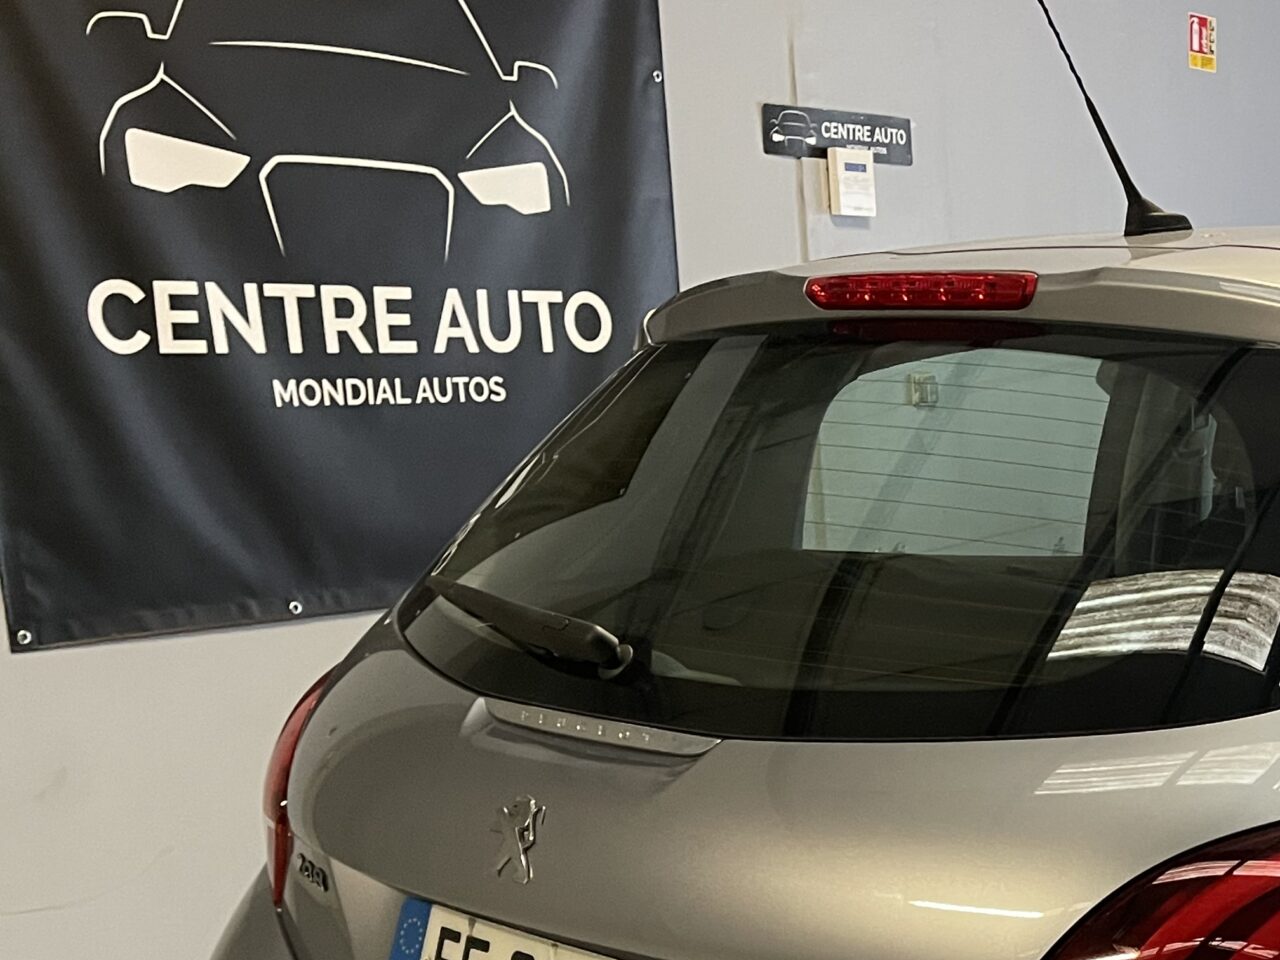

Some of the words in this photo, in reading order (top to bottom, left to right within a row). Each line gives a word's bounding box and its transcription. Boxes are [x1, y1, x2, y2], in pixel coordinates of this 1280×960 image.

[821, 121, 872, 142] CENTRE
[872, 127, 907, 145] AUTO
[87, 278, 418, 355] CENTRE
[433, 287, 613, 354] AUTO
[272, 376, 411, 408] MONDIAL
[415, 375, 507, 405] AUTOS
